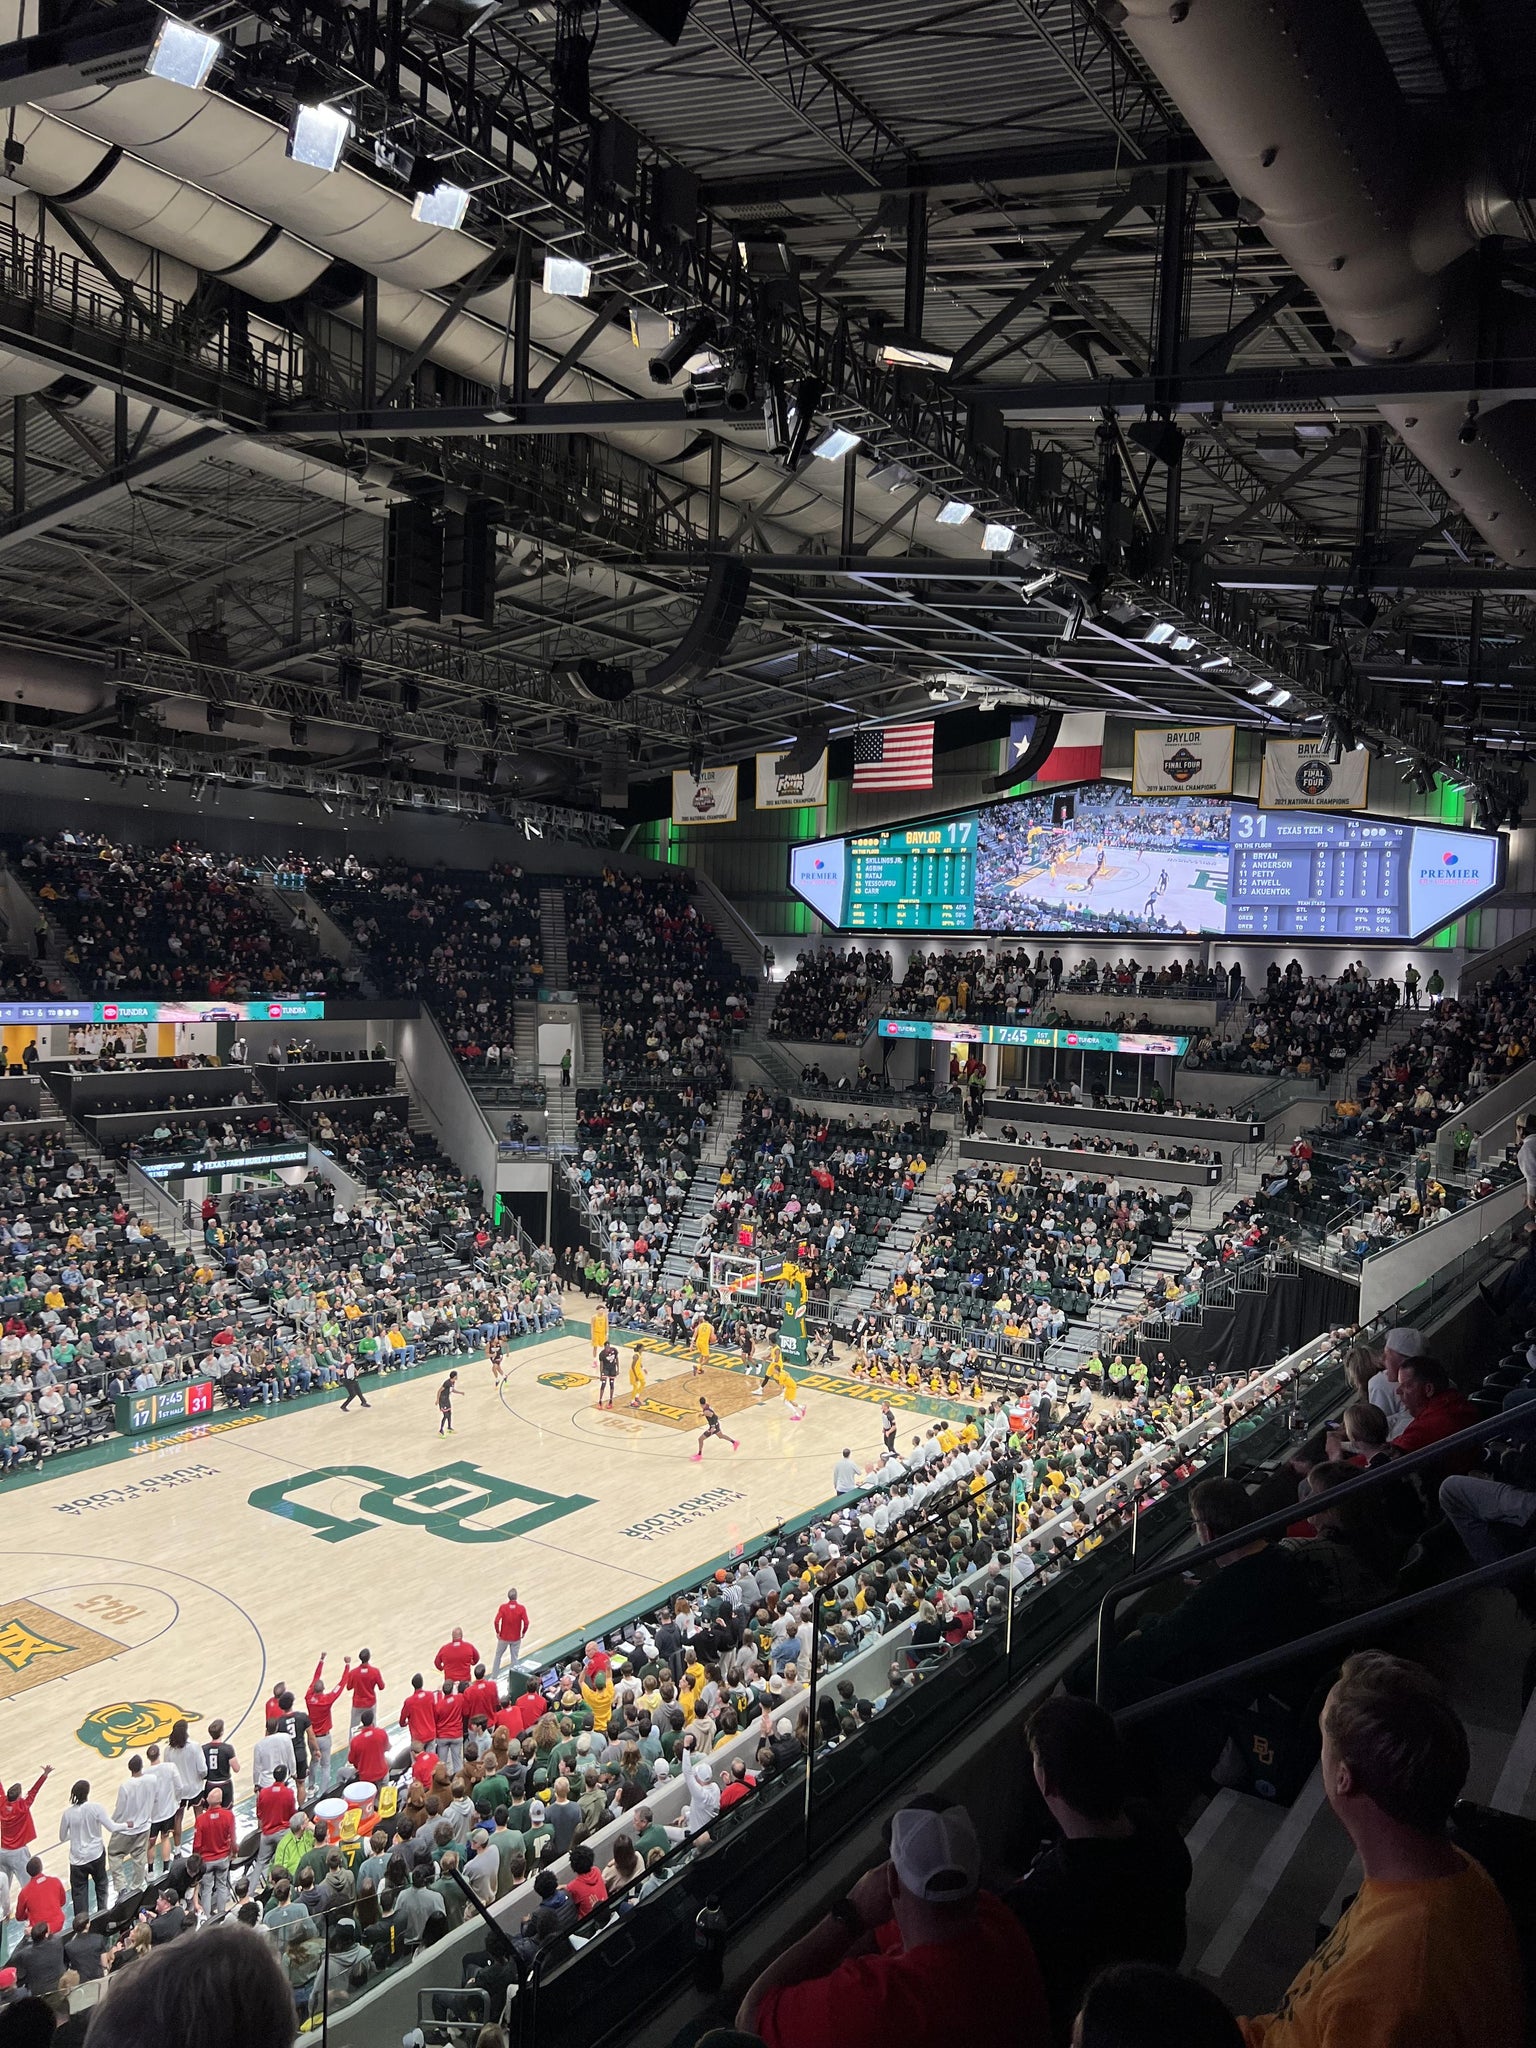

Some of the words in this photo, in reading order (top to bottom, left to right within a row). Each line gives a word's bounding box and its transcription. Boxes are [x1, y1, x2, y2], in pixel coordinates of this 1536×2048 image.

[1167, 732, 1200, 742] BAYLOR
[1165, 761, 1182, 770] FINAL
[1184, 760, 1201, 768] FOUR
[778, 780, 804, 791] FOUR
[948, 823, 972, 844] 17
[1238, 815, 1267, 838] 31
[1277, 827, 1301, 835] TEXAS
[906, 831, 941, 844] BAYLOR
[1420, 870, 1479, 878] PREMIER
[119, 1008, 148, 1016] TUNDRA
[282, 1007, 306, 1015] TUNDRA
[1000, 1030, 1028, 1042] 7:45
[203, 1161, 225, 1169] TEXAS
[226, 1159, 244, 1167] FARM
[245, 1157, 270, 1165] BUREAU
[271, 1152, 306, 1162] INSURANCE
[785, 1302, 794, 1315] BU
[624, 1338, 744, 1369] BAYLOR
[798, 1375, 916, 1406] BEARS
[159, 1392, 182, 1407] 7:45
[193, 1396, 207, 1411] 31
[170, 1407, 184, 1416] HALF
[637, 1398, 701, 1420] XII
[133, 1410, 149, 1427] 17
[210, 1414, 266, 1433] FOSTER
[595, 1417, 648, 1432] 1845
[138, 1464, 210, 1488] HURD
[168, 1468, 222, 1488] MARK
[51, 1484, 140, 1512] FLOOR
[67, 1493, 142, 1516] PAULA
[678, 1487, 733, 1510] HURD
[705, 1491, 748, 1512] MARK
[618, 1508, 686, 1537] FLOOR
[640, 1516, 694, 1541] PAULA
[73, 1594, 148, 1625] 1845
[287, 1723, 297, 1738] 3
[1252, 1734, 1274, 1766] BU
[210, 1754, 218, 1770] 8
[347, 1850, 355, 1867] 7
